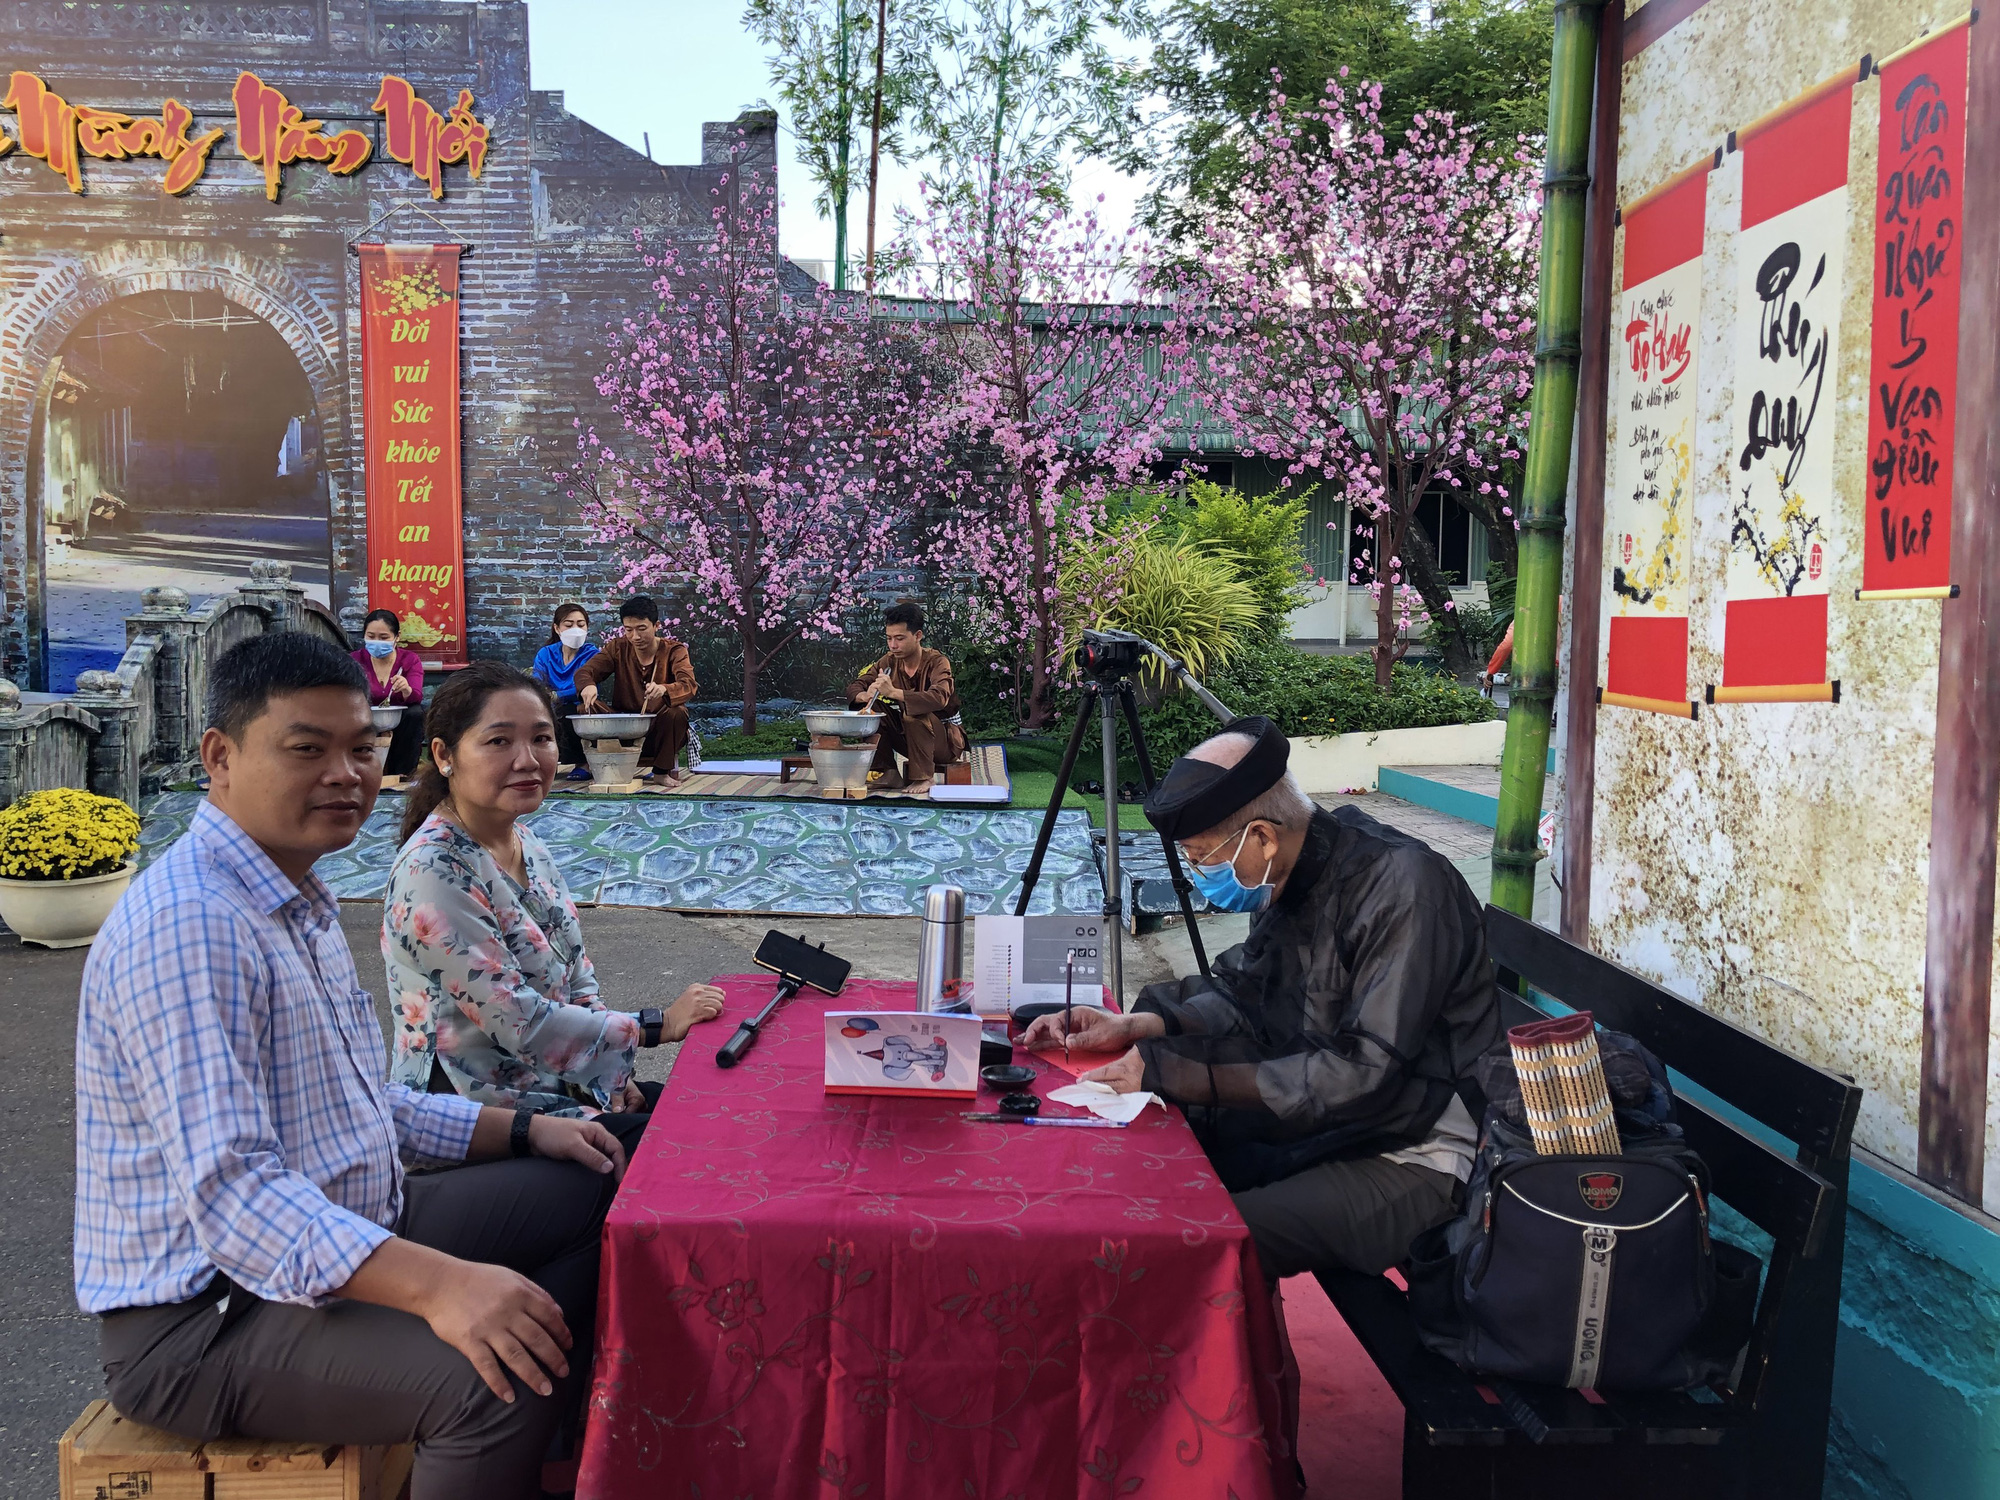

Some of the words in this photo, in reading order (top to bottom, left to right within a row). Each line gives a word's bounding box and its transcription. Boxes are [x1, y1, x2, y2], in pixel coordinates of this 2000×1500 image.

[232, 71, 373, 201] Năm
[372, 75, 489, 200] Mới
[391, 318, 431, 343] Đời
[393, 359, 430, 383] vui
[391, 398, 434, 423] Sức
[385, 438, 441, 463] khỏe
[397, 475, 433, 503] Tết
[398, 525, 430, 542] an
[378, 559, 453, 588] khang
[1583, 1187, 1618, 1196] UOMO
[1580, 1317, 1599, 1361] UOMO
